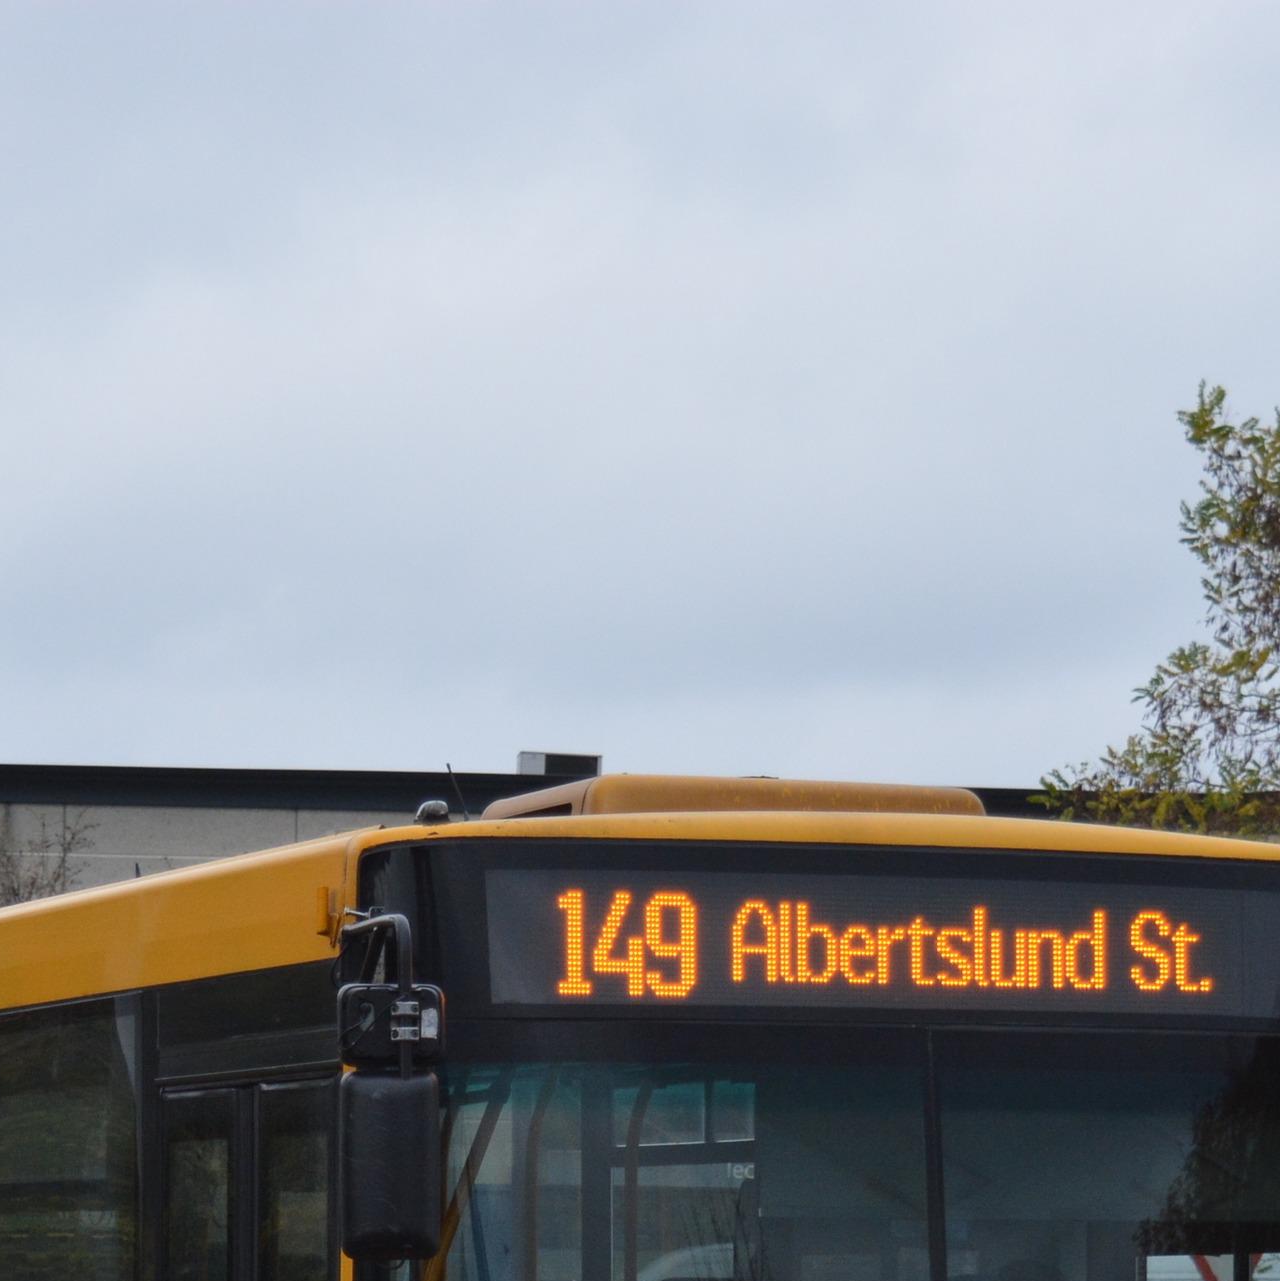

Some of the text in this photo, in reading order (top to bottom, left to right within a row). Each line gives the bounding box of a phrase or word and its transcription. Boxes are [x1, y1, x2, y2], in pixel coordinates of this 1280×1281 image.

[557, 890, 1213, 998] 149 Albertslund St.
